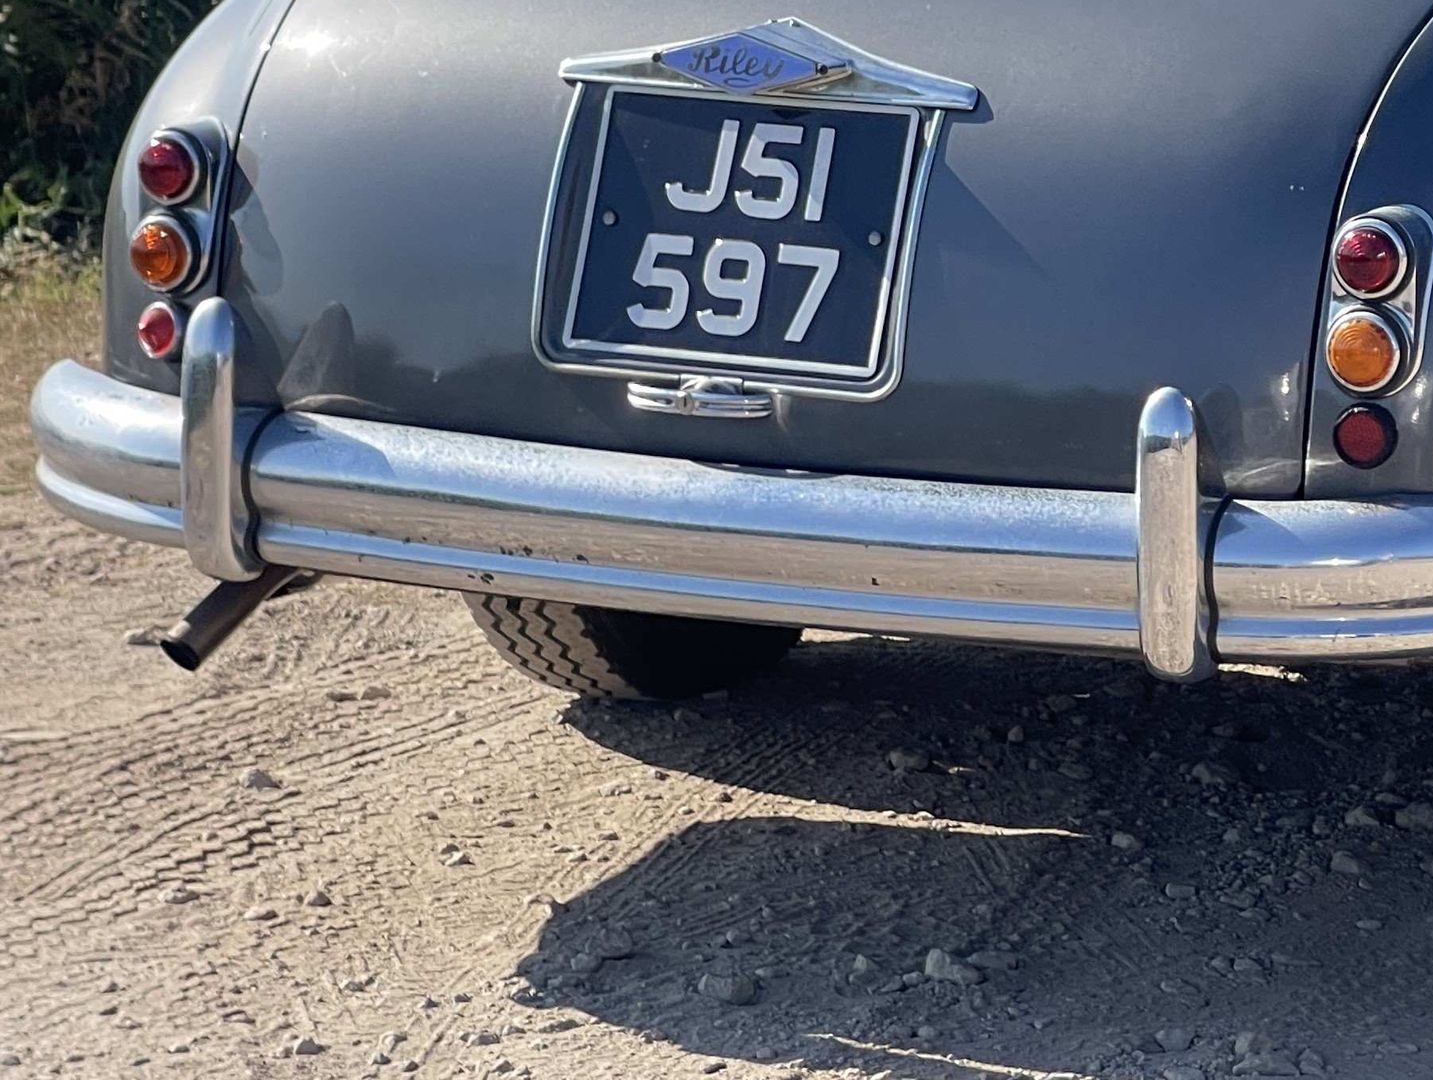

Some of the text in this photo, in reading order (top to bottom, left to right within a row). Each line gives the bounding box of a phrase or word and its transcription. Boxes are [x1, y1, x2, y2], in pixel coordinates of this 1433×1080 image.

[687, 44, 785, 88] Riley
[665, 119, 836, 222] J51
[626, 233, 841, 343] 597
